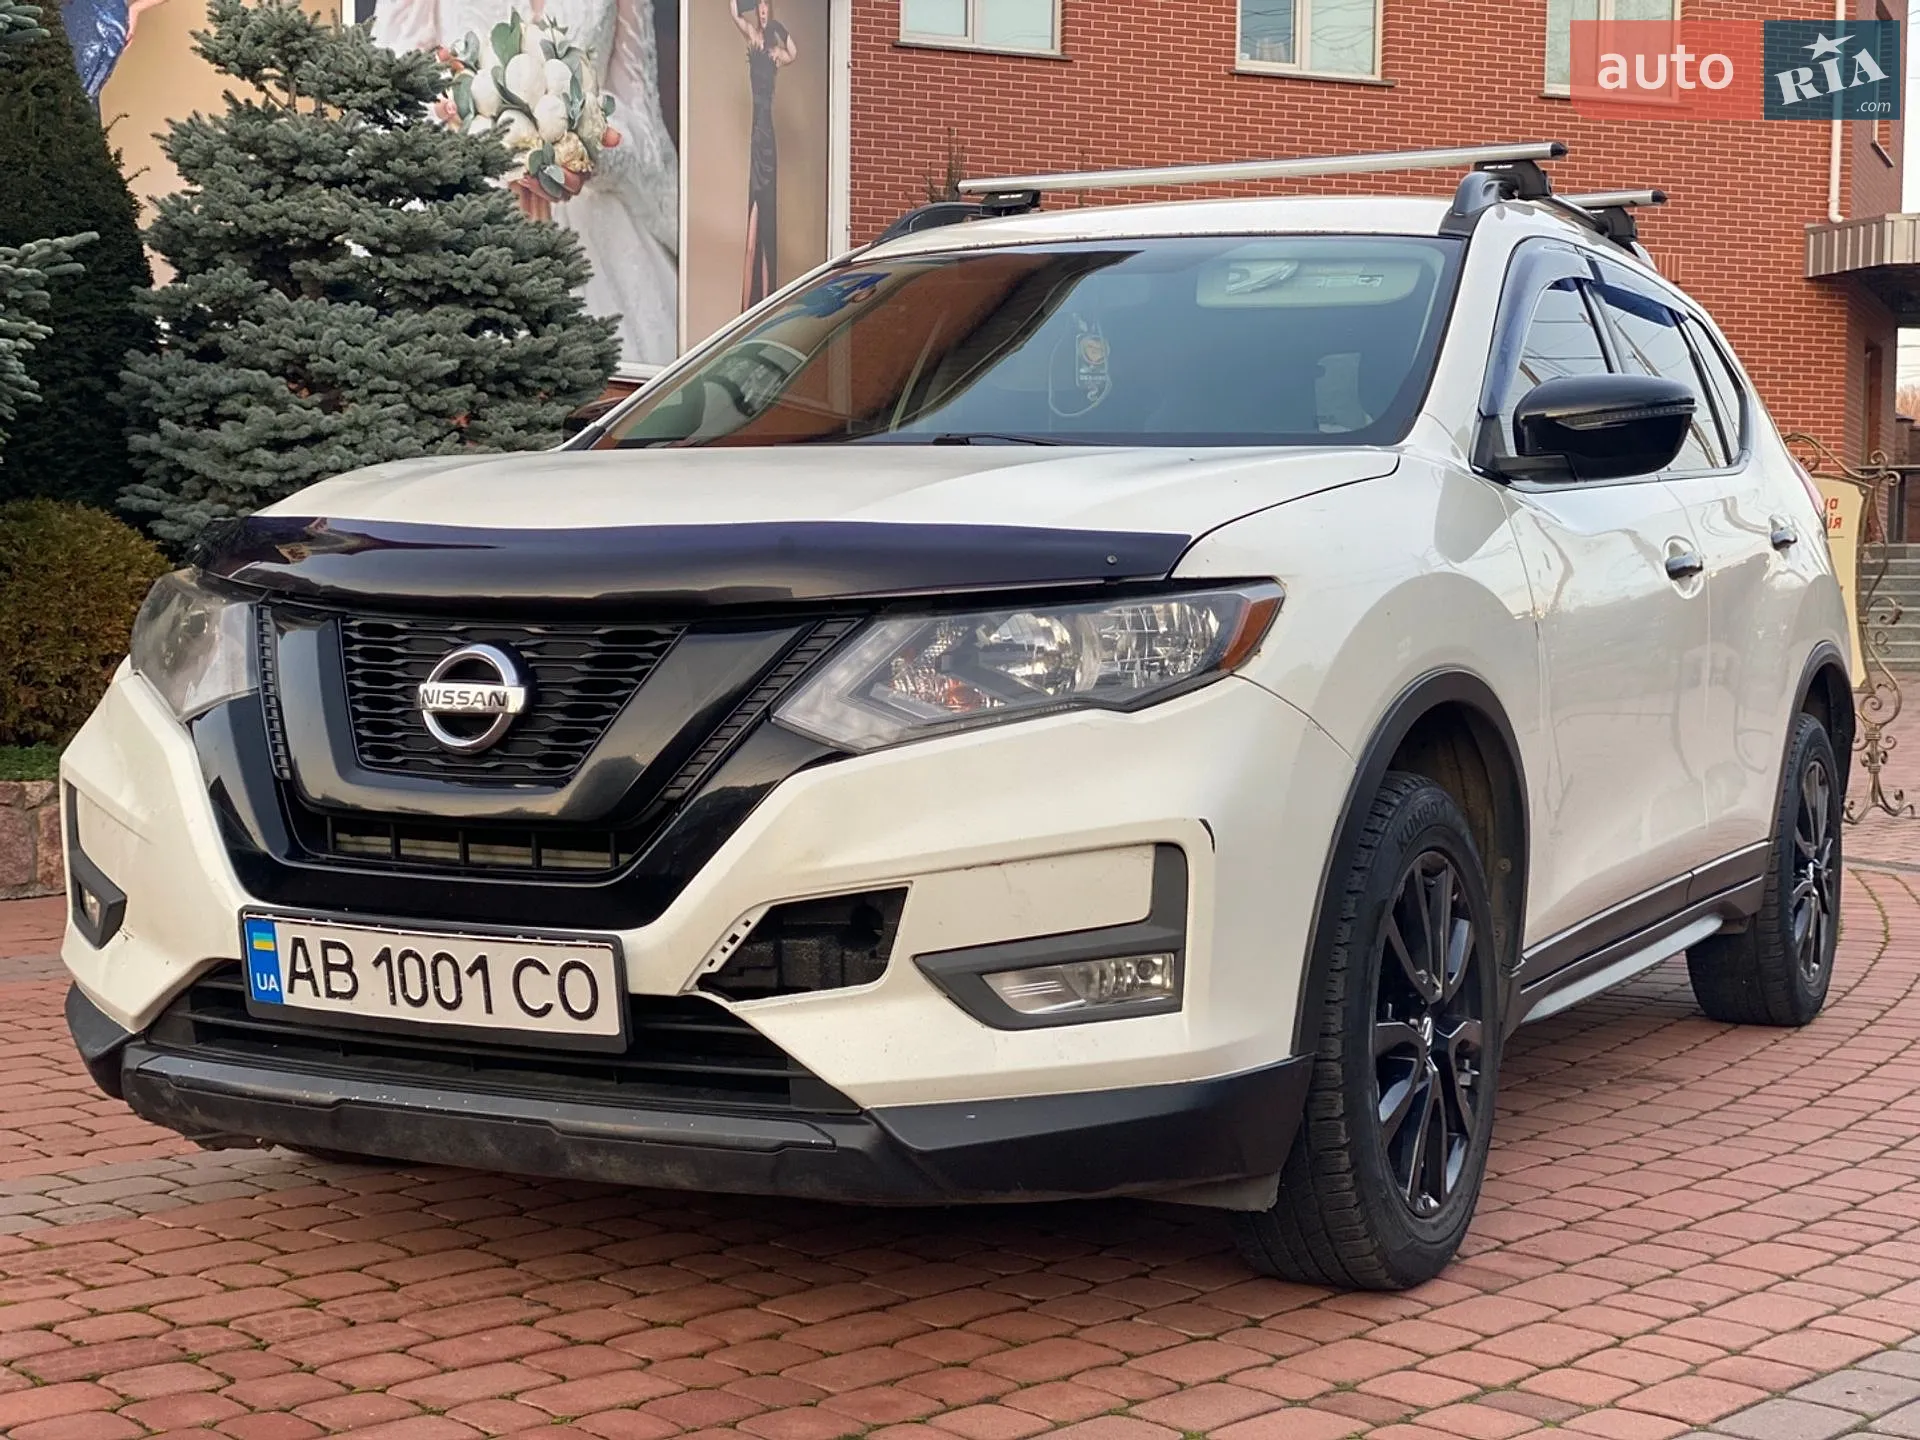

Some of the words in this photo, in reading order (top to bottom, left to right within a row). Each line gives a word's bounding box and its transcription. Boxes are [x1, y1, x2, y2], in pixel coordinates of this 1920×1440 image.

[421, 689, 509, 707] NISSAN
[256, 973, 280, 992] UA
[286, 936, 359, 1000] AB
[372, 946, 494, 1015] 1001
[512, 957, 599, 1021] CO
